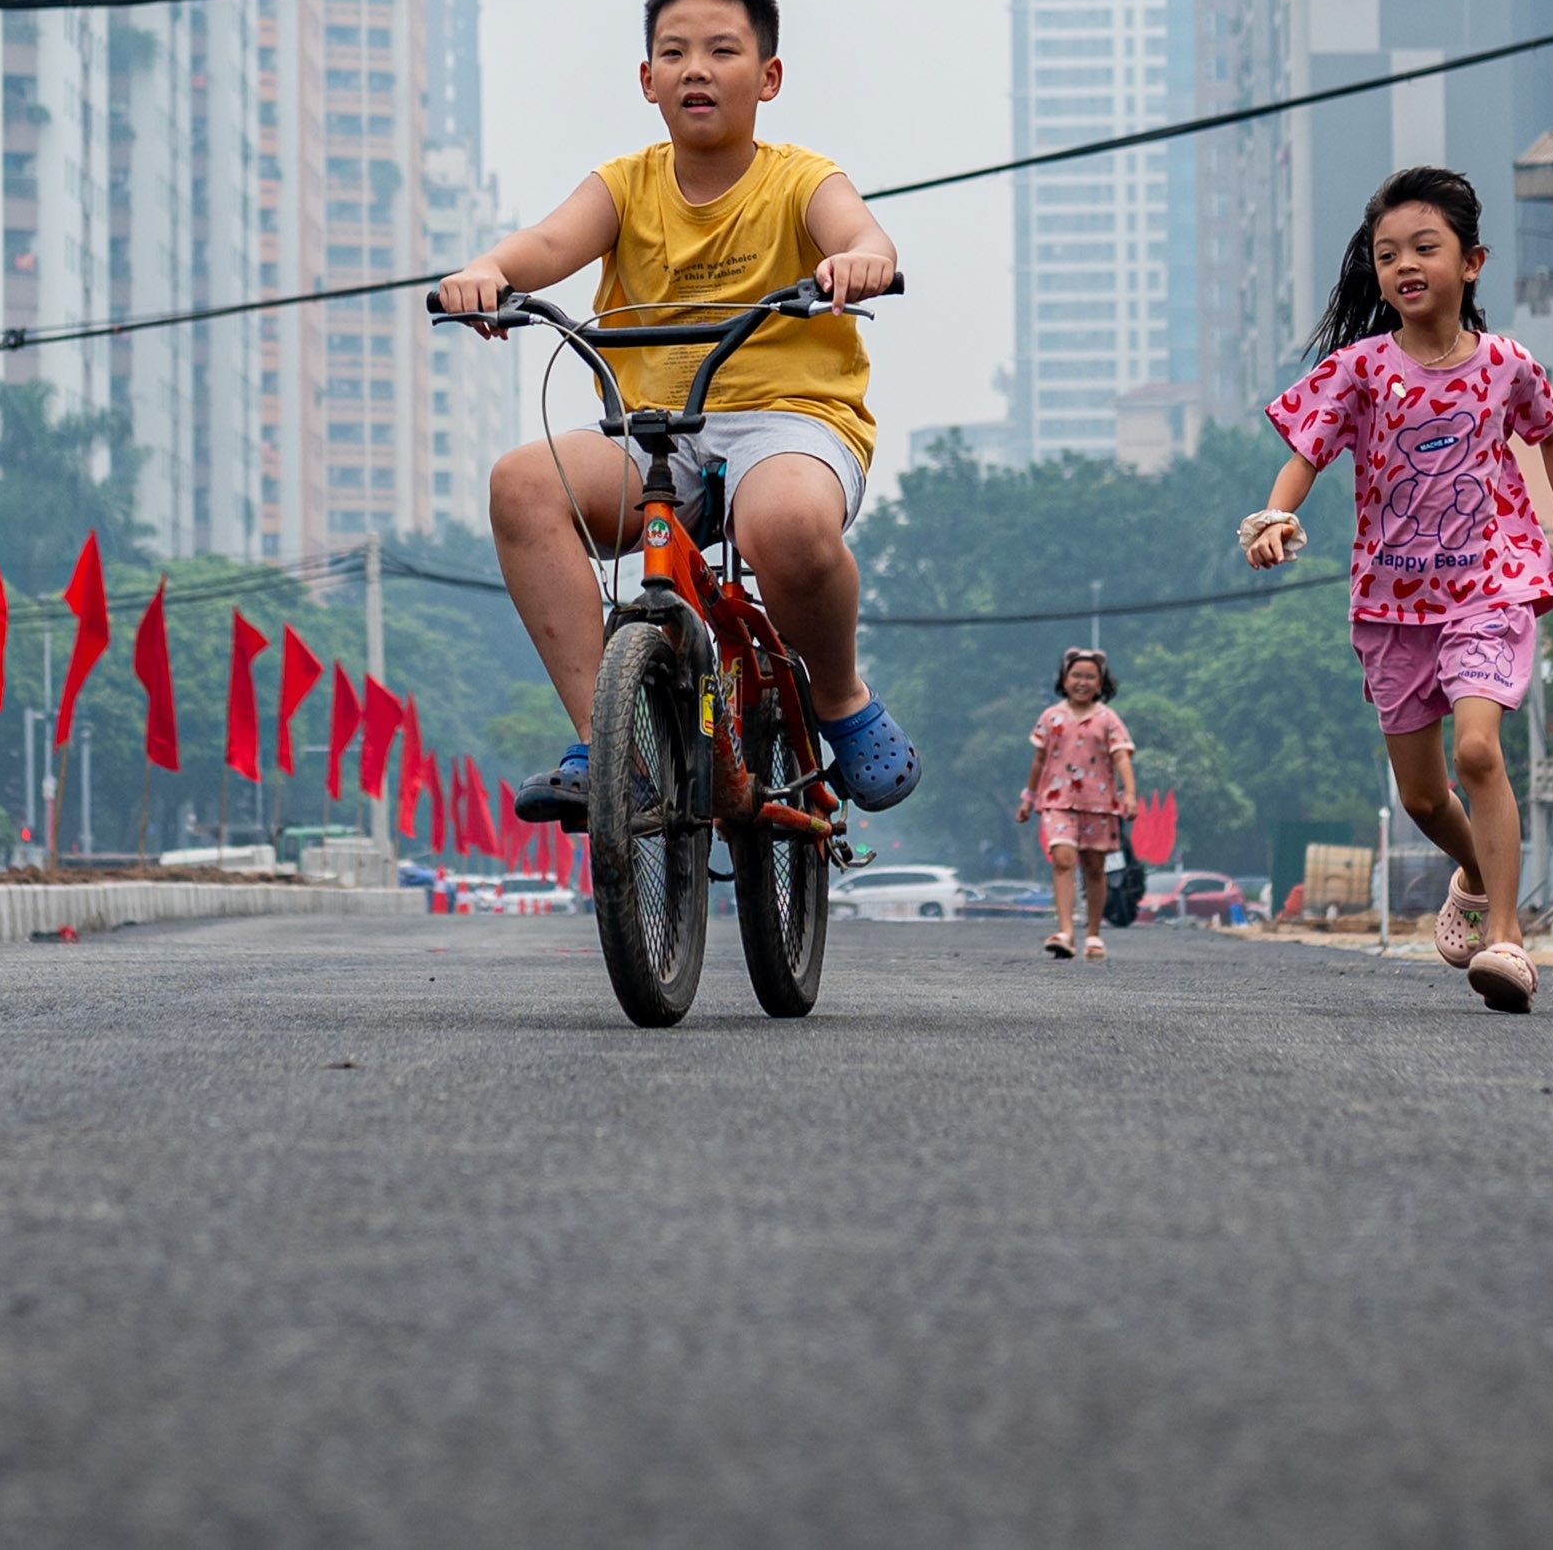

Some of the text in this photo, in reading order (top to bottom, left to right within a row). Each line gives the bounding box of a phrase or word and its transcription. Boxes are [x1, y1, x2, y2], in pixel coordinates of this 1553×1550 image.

[726, 253, 757, 265] choice
[684, 272, 704, 281] this
[1371, 550, 1477, 572] Happy Bear
